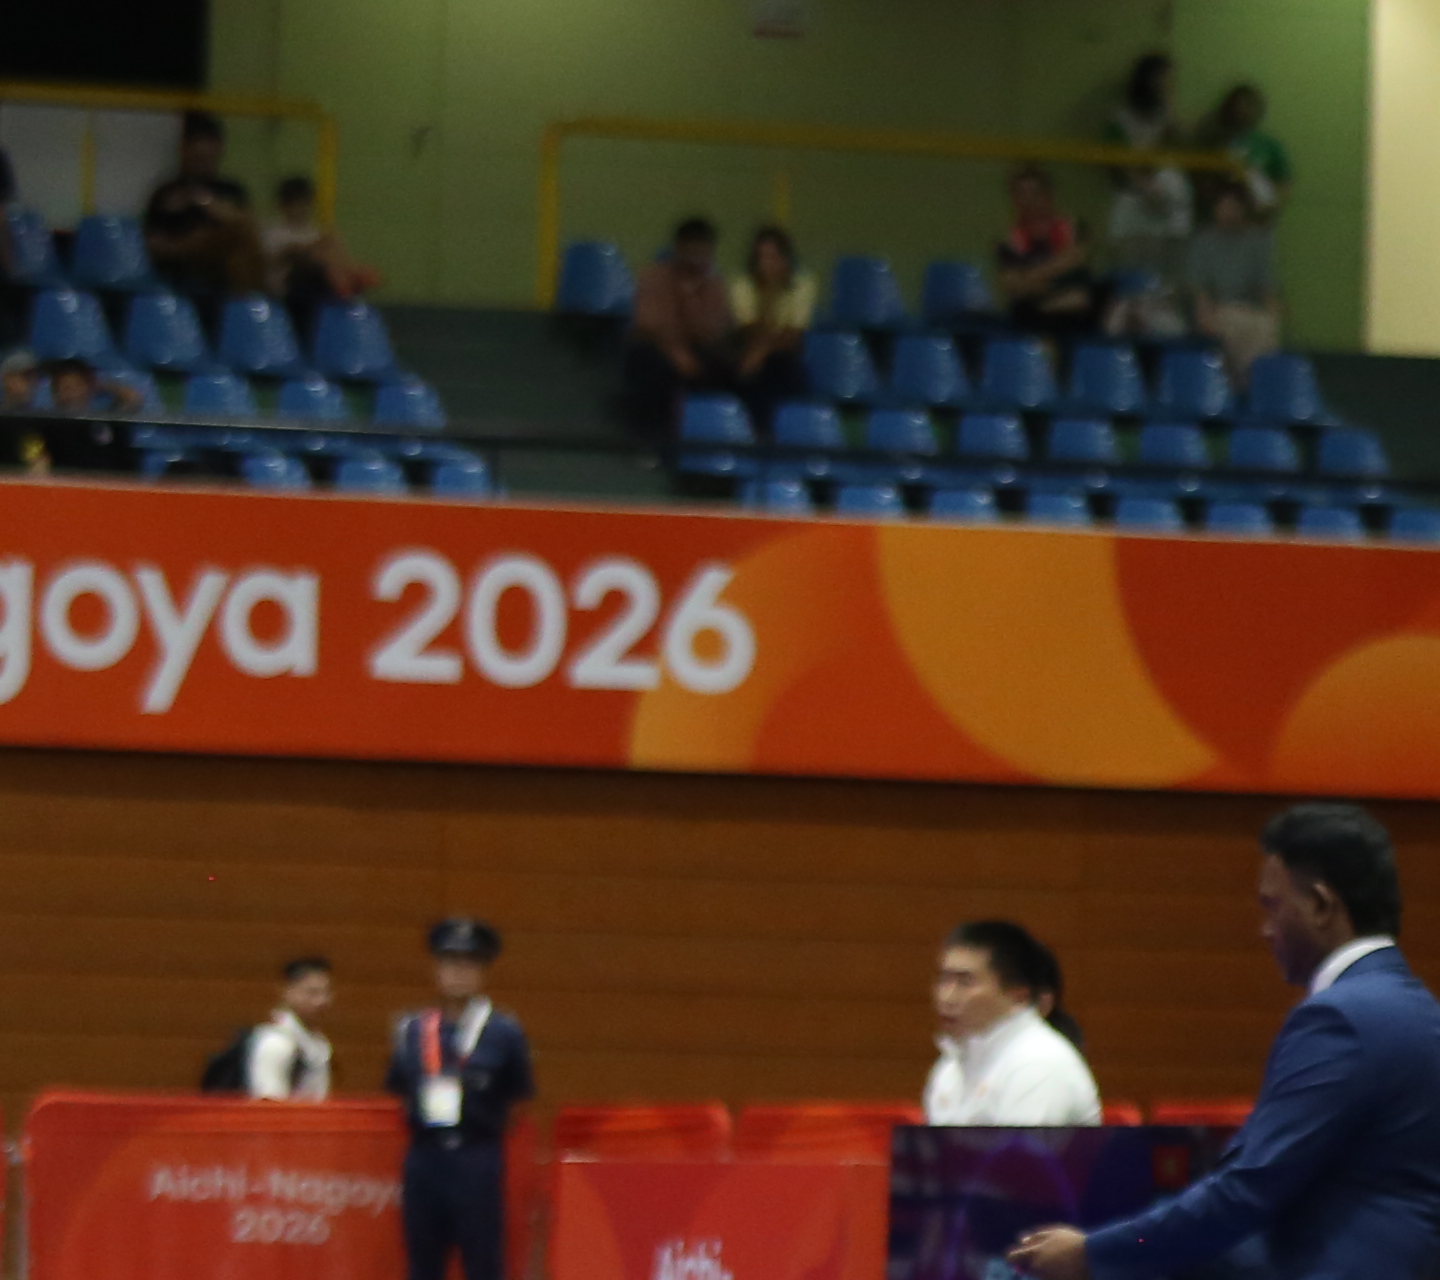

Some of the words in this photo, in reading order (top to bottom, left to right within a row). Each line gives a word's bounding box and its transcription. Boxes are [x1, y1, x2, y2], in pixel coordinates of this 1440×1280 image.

[368, 546, 757, 695] 2026
[148, 1165, 403, 1217] Aichi-Nagoy
[230, 1208, 331, 1245] 2026
